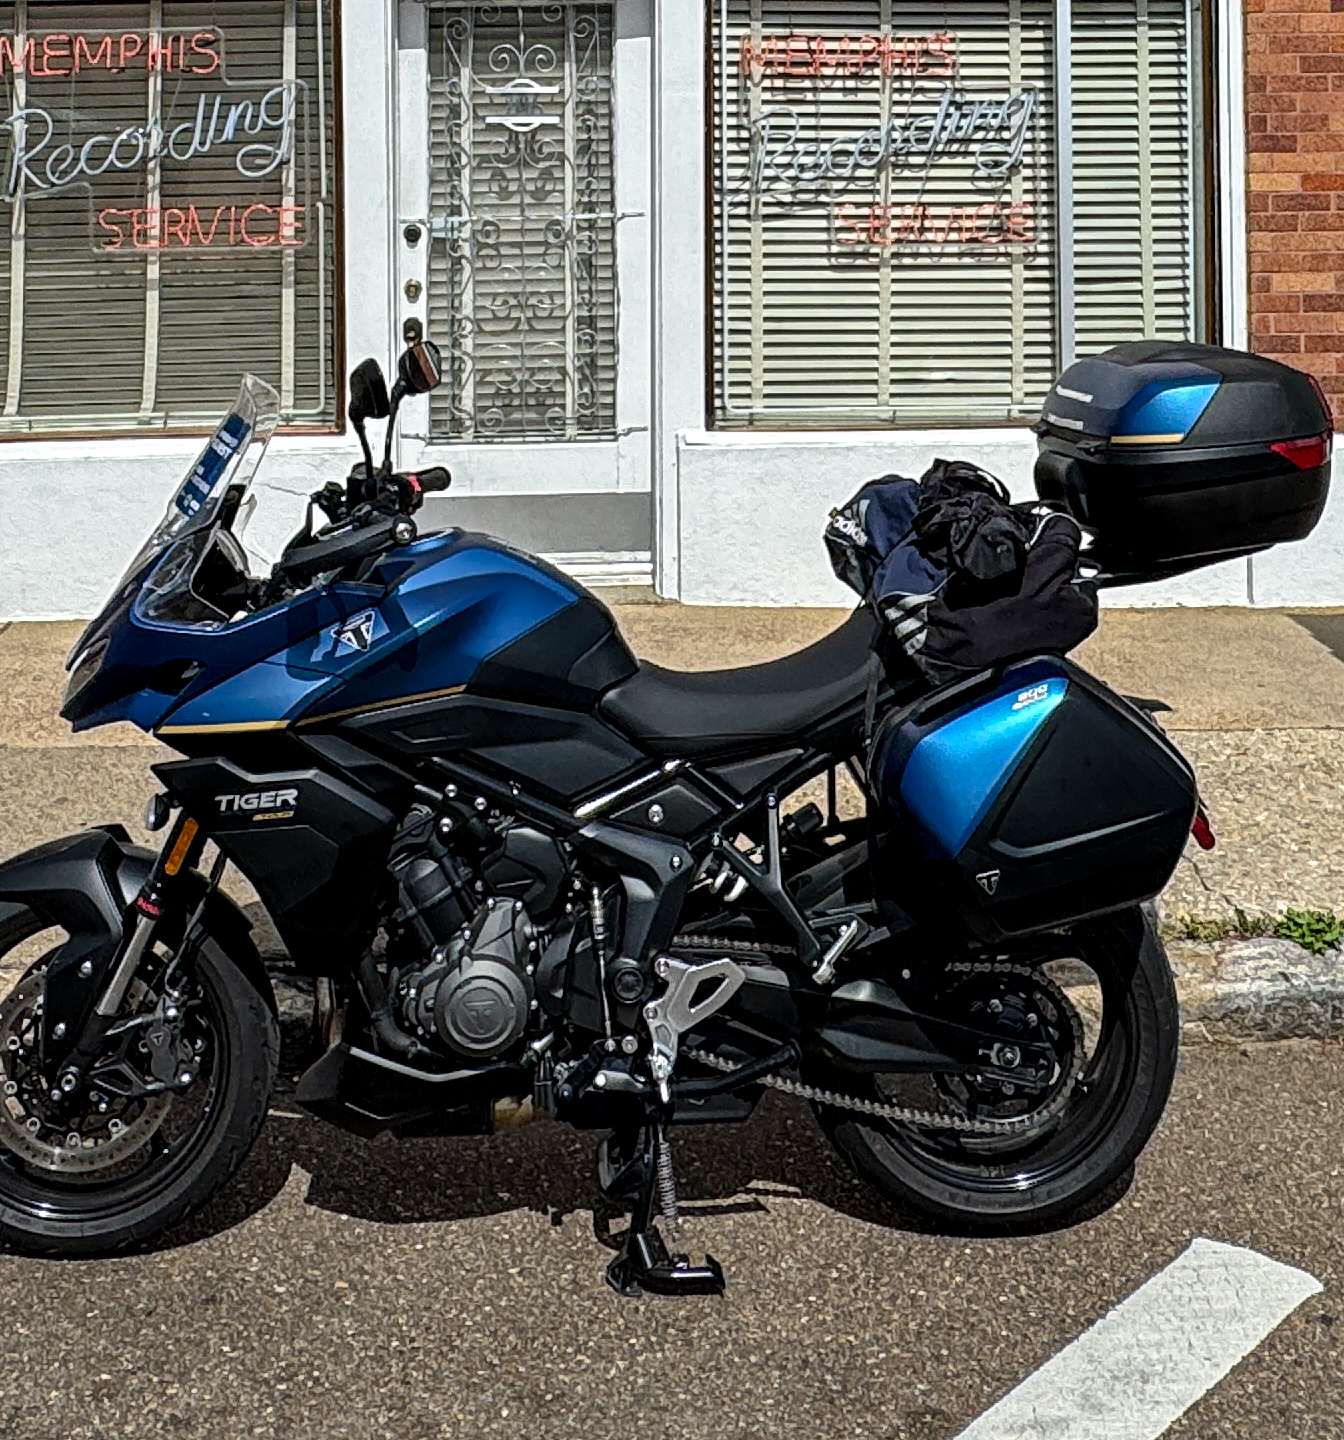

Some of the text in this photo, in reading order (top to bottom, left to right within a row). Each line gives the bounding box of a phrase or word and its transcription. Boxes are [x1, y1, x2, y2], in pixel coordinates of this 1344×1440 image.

[743, 33, 954, 76] MEMPHIS
[6, 82, 297, 200] Recording
[754, 87, 1036, 192] Recording
[98, 205, 305, 249] SERVICE
[837, 203, 1035, 244] SERVICE
[214, 789, 298, 811] TIGER
